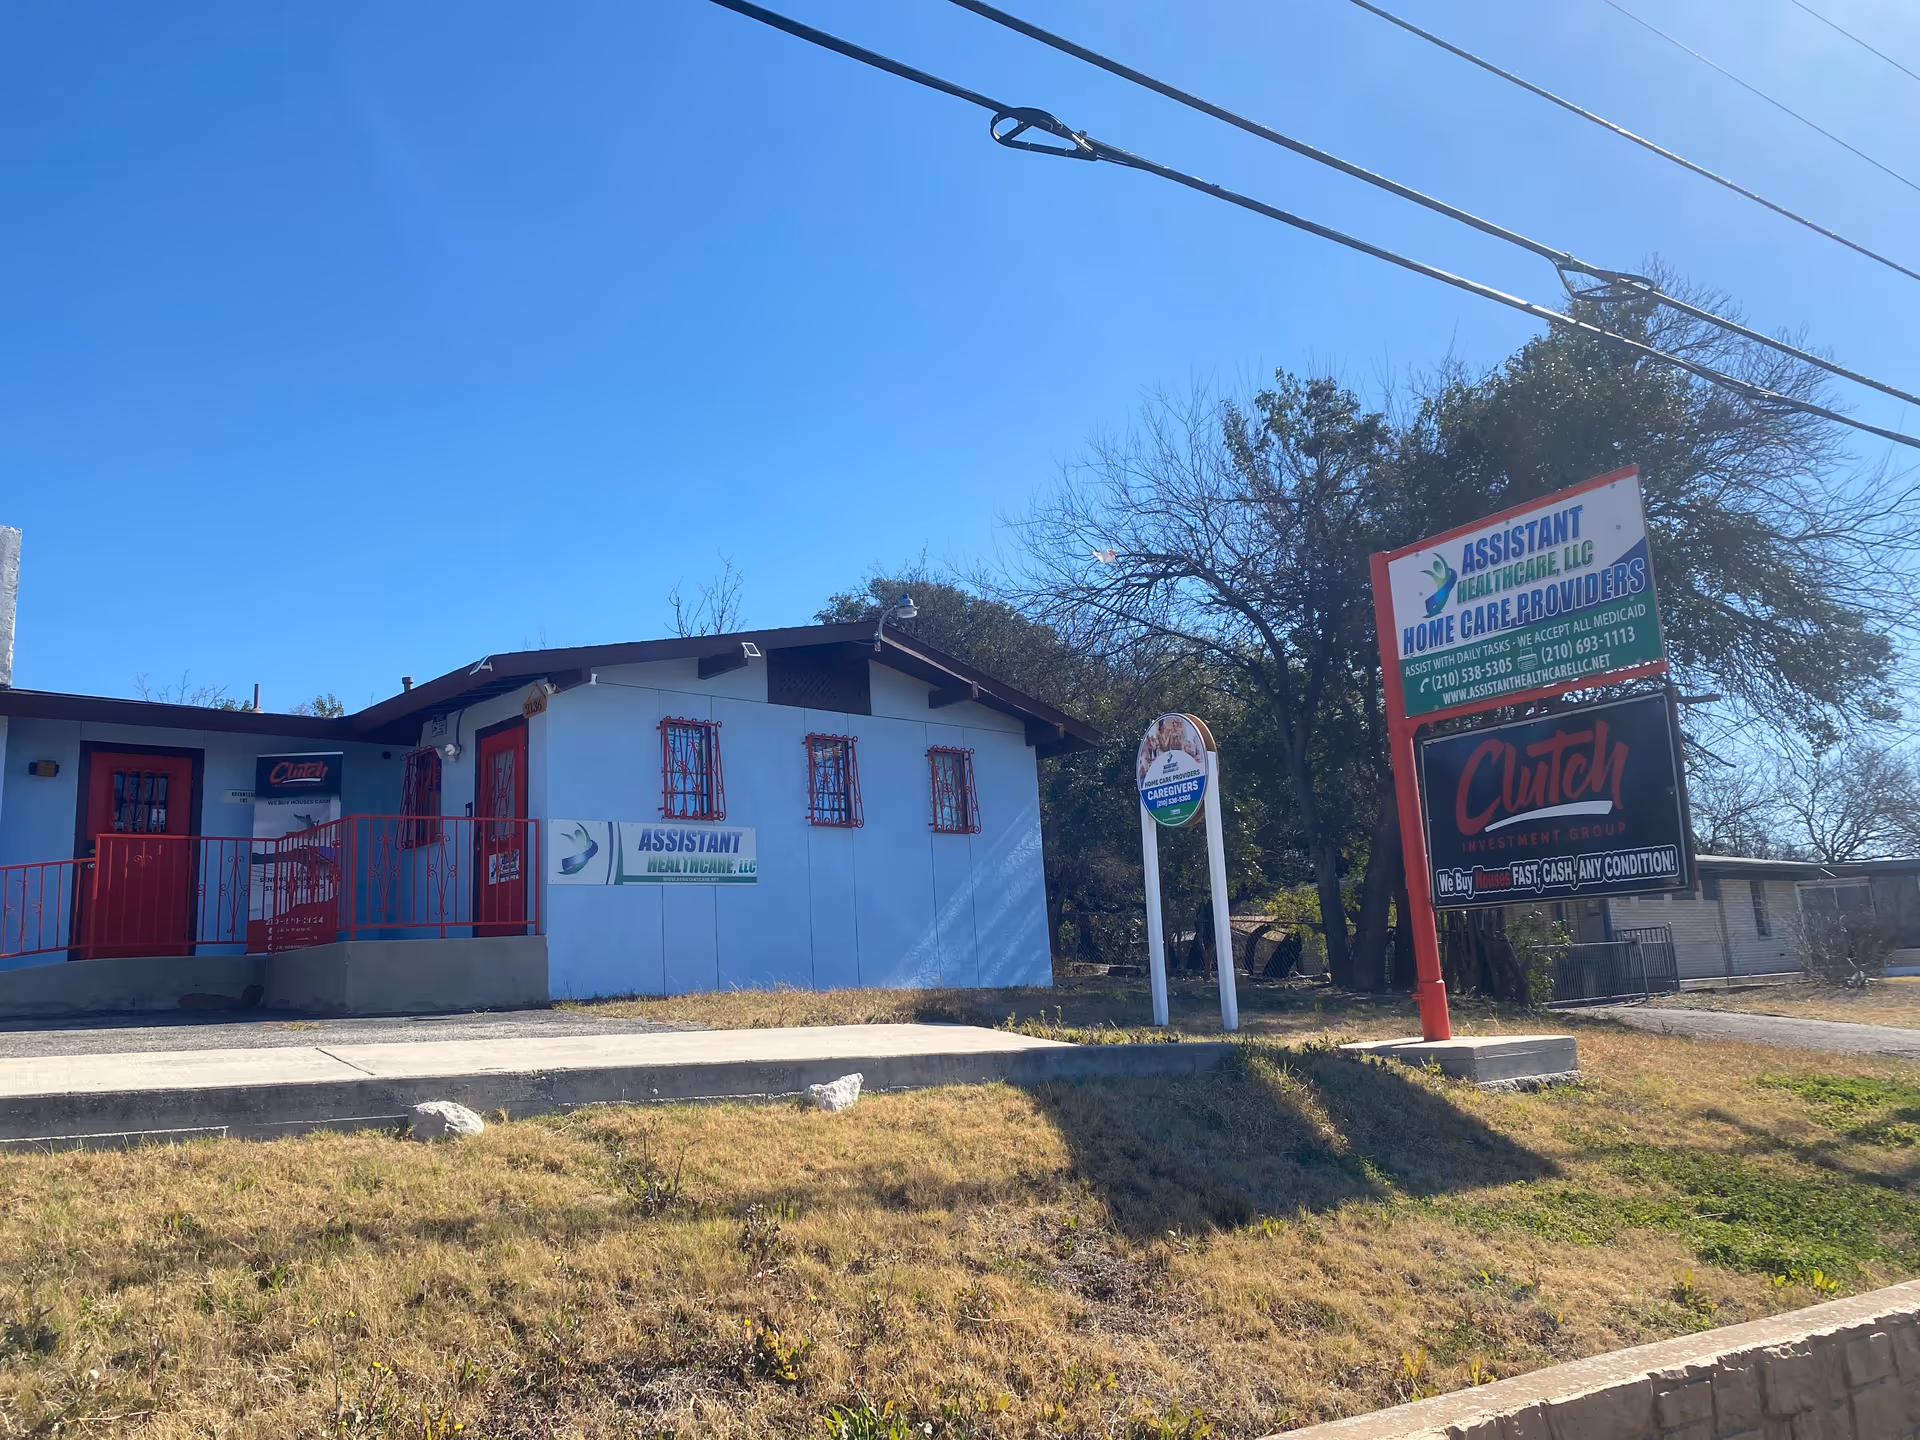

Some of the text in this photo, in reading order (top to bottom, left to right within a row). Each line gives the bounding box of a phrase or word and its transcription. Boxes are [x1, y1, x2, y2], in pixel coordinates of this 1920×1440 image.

[1461, 504, 1584, 577] ASSISTANT
[1456, 539, 1594, 605] HEALTHCARE, LLC
[1403, 556, 1646, 657] HOME CARE PROVIDERS
[1405, 659, 1432, 677] ASSIST
[1432, 655, 1456, 672] WITH
[1456, 647, 1482, 666] DAILY
[1481, 640, 1511, 660] TASKS
[1516, 634, 1533, 648] WE
[1534, 625, 1570, 645] ACCEPT
[1573, 619, 1591, 634] ALL
[1593, 603, 1646, 628] MEDICAID
[1432, 626, 1636, 692] (210) 538-5305 (210) 693-1113
[1442, 654, 1611, 705] WWW.ASSISTANTHEALTHCARELLC.NET
[524, 700, 543, 715] 2136
[269, 760, 329, 784] Clutch
[1145, 779, 1159, 788] HOME
[1159, 775, 1172, 784] CARE
[1172, 769, 1200, 781] PROVIDERS
[1147, 780, 1199, 801] CAREGIVERS
[1456, 719, 1629, 836] Clutch
[638, 828, 743, 854] ASSISTANT
[1462, 821, 1626, 853] INVESTMENT GROUP
[647, 856, 757, 875] HEALTHCARE, LLC
[1439, 873, 1454, 892] We
[1455, 871, 1473, 894] Buy
[1474, 867, 1511, 889] Houses
[1543, 861, 1576, 887] CASH,
[1579, 858, 1602, 880] ANY
[1604, 850, 1675, 876] CONDITION!
